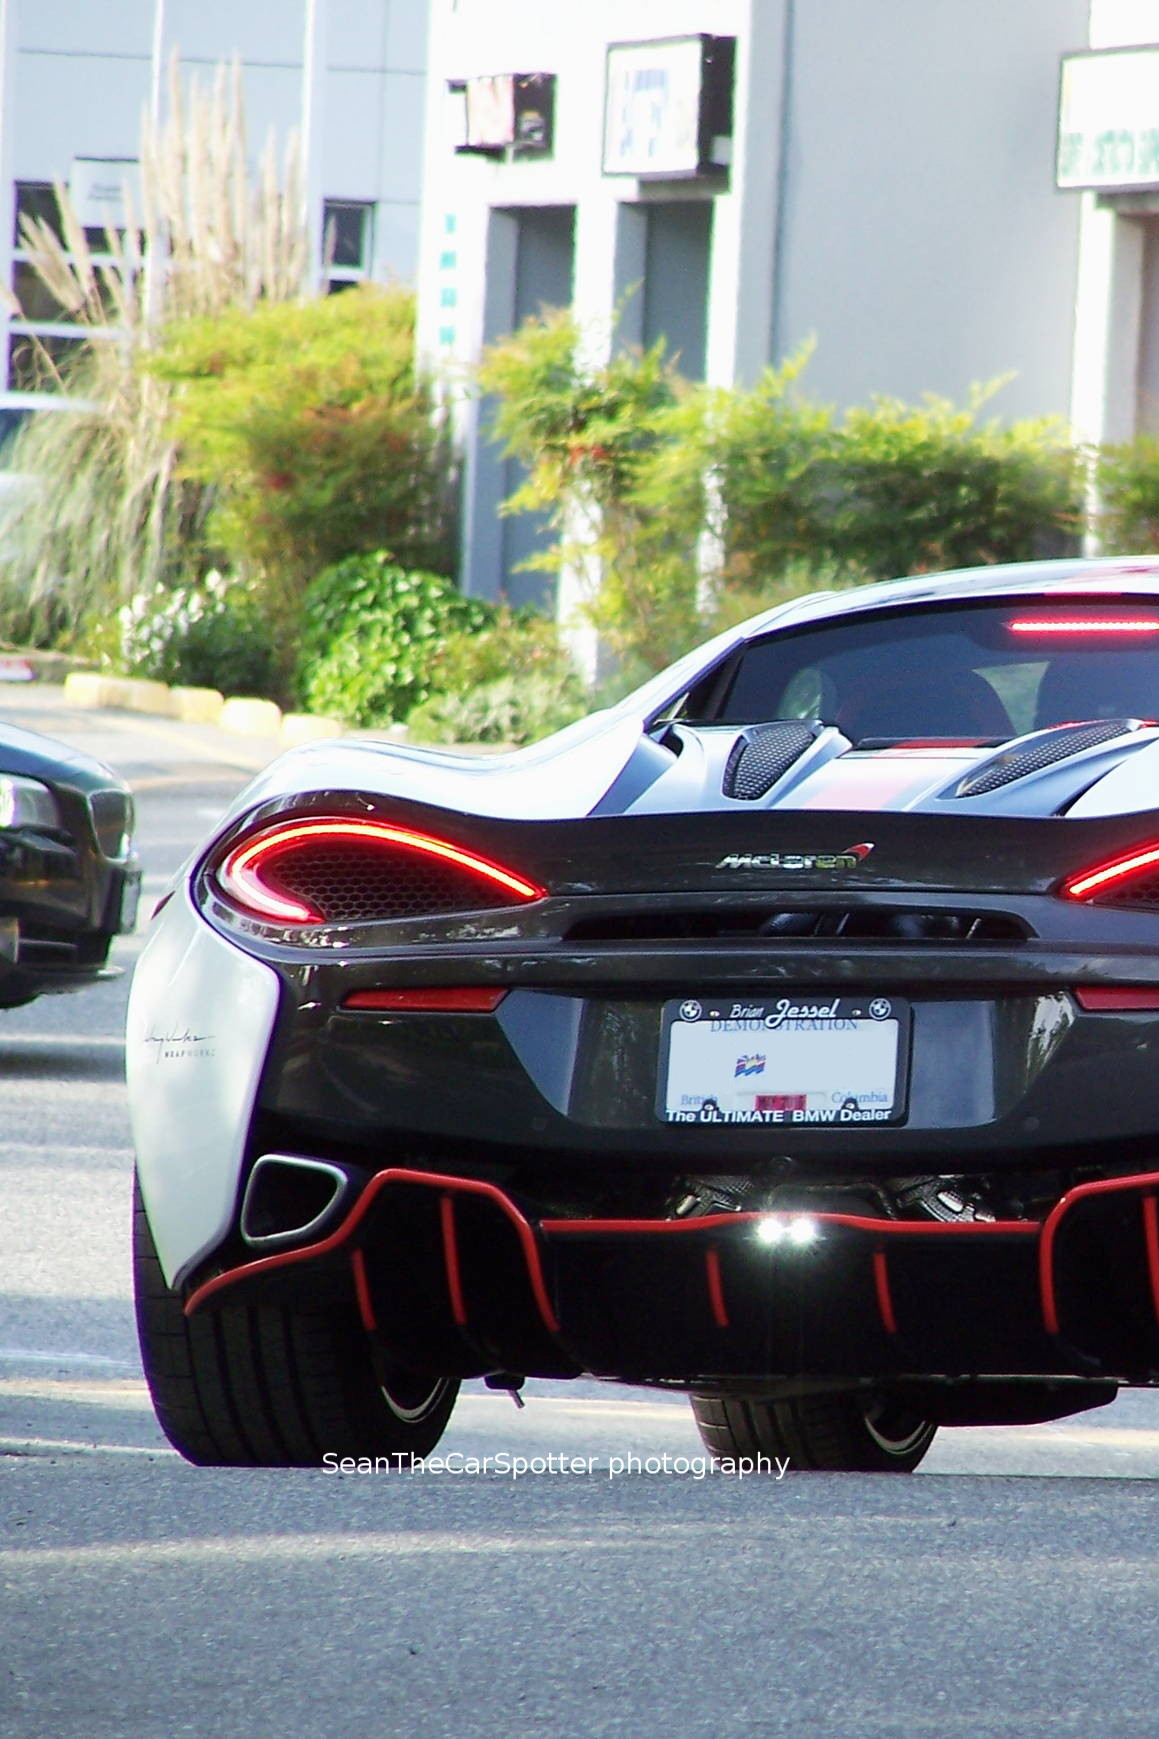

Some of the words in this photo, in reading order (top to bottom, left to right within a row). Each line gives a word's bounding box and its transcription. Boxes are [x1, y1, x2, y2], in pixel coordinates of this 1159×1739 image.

[715, 853, 857, 869] McLaren
[729, 1004, 765, 1019] Brian
[764, 998, 841, 1028] Jessel
[666, 1109, 695, 1122] The
[700, 1109, 784, 1122] ULTIMATE
[792, 1109, 836, 1122] BMW
[840, 1108, 892, 1121] Dealer
